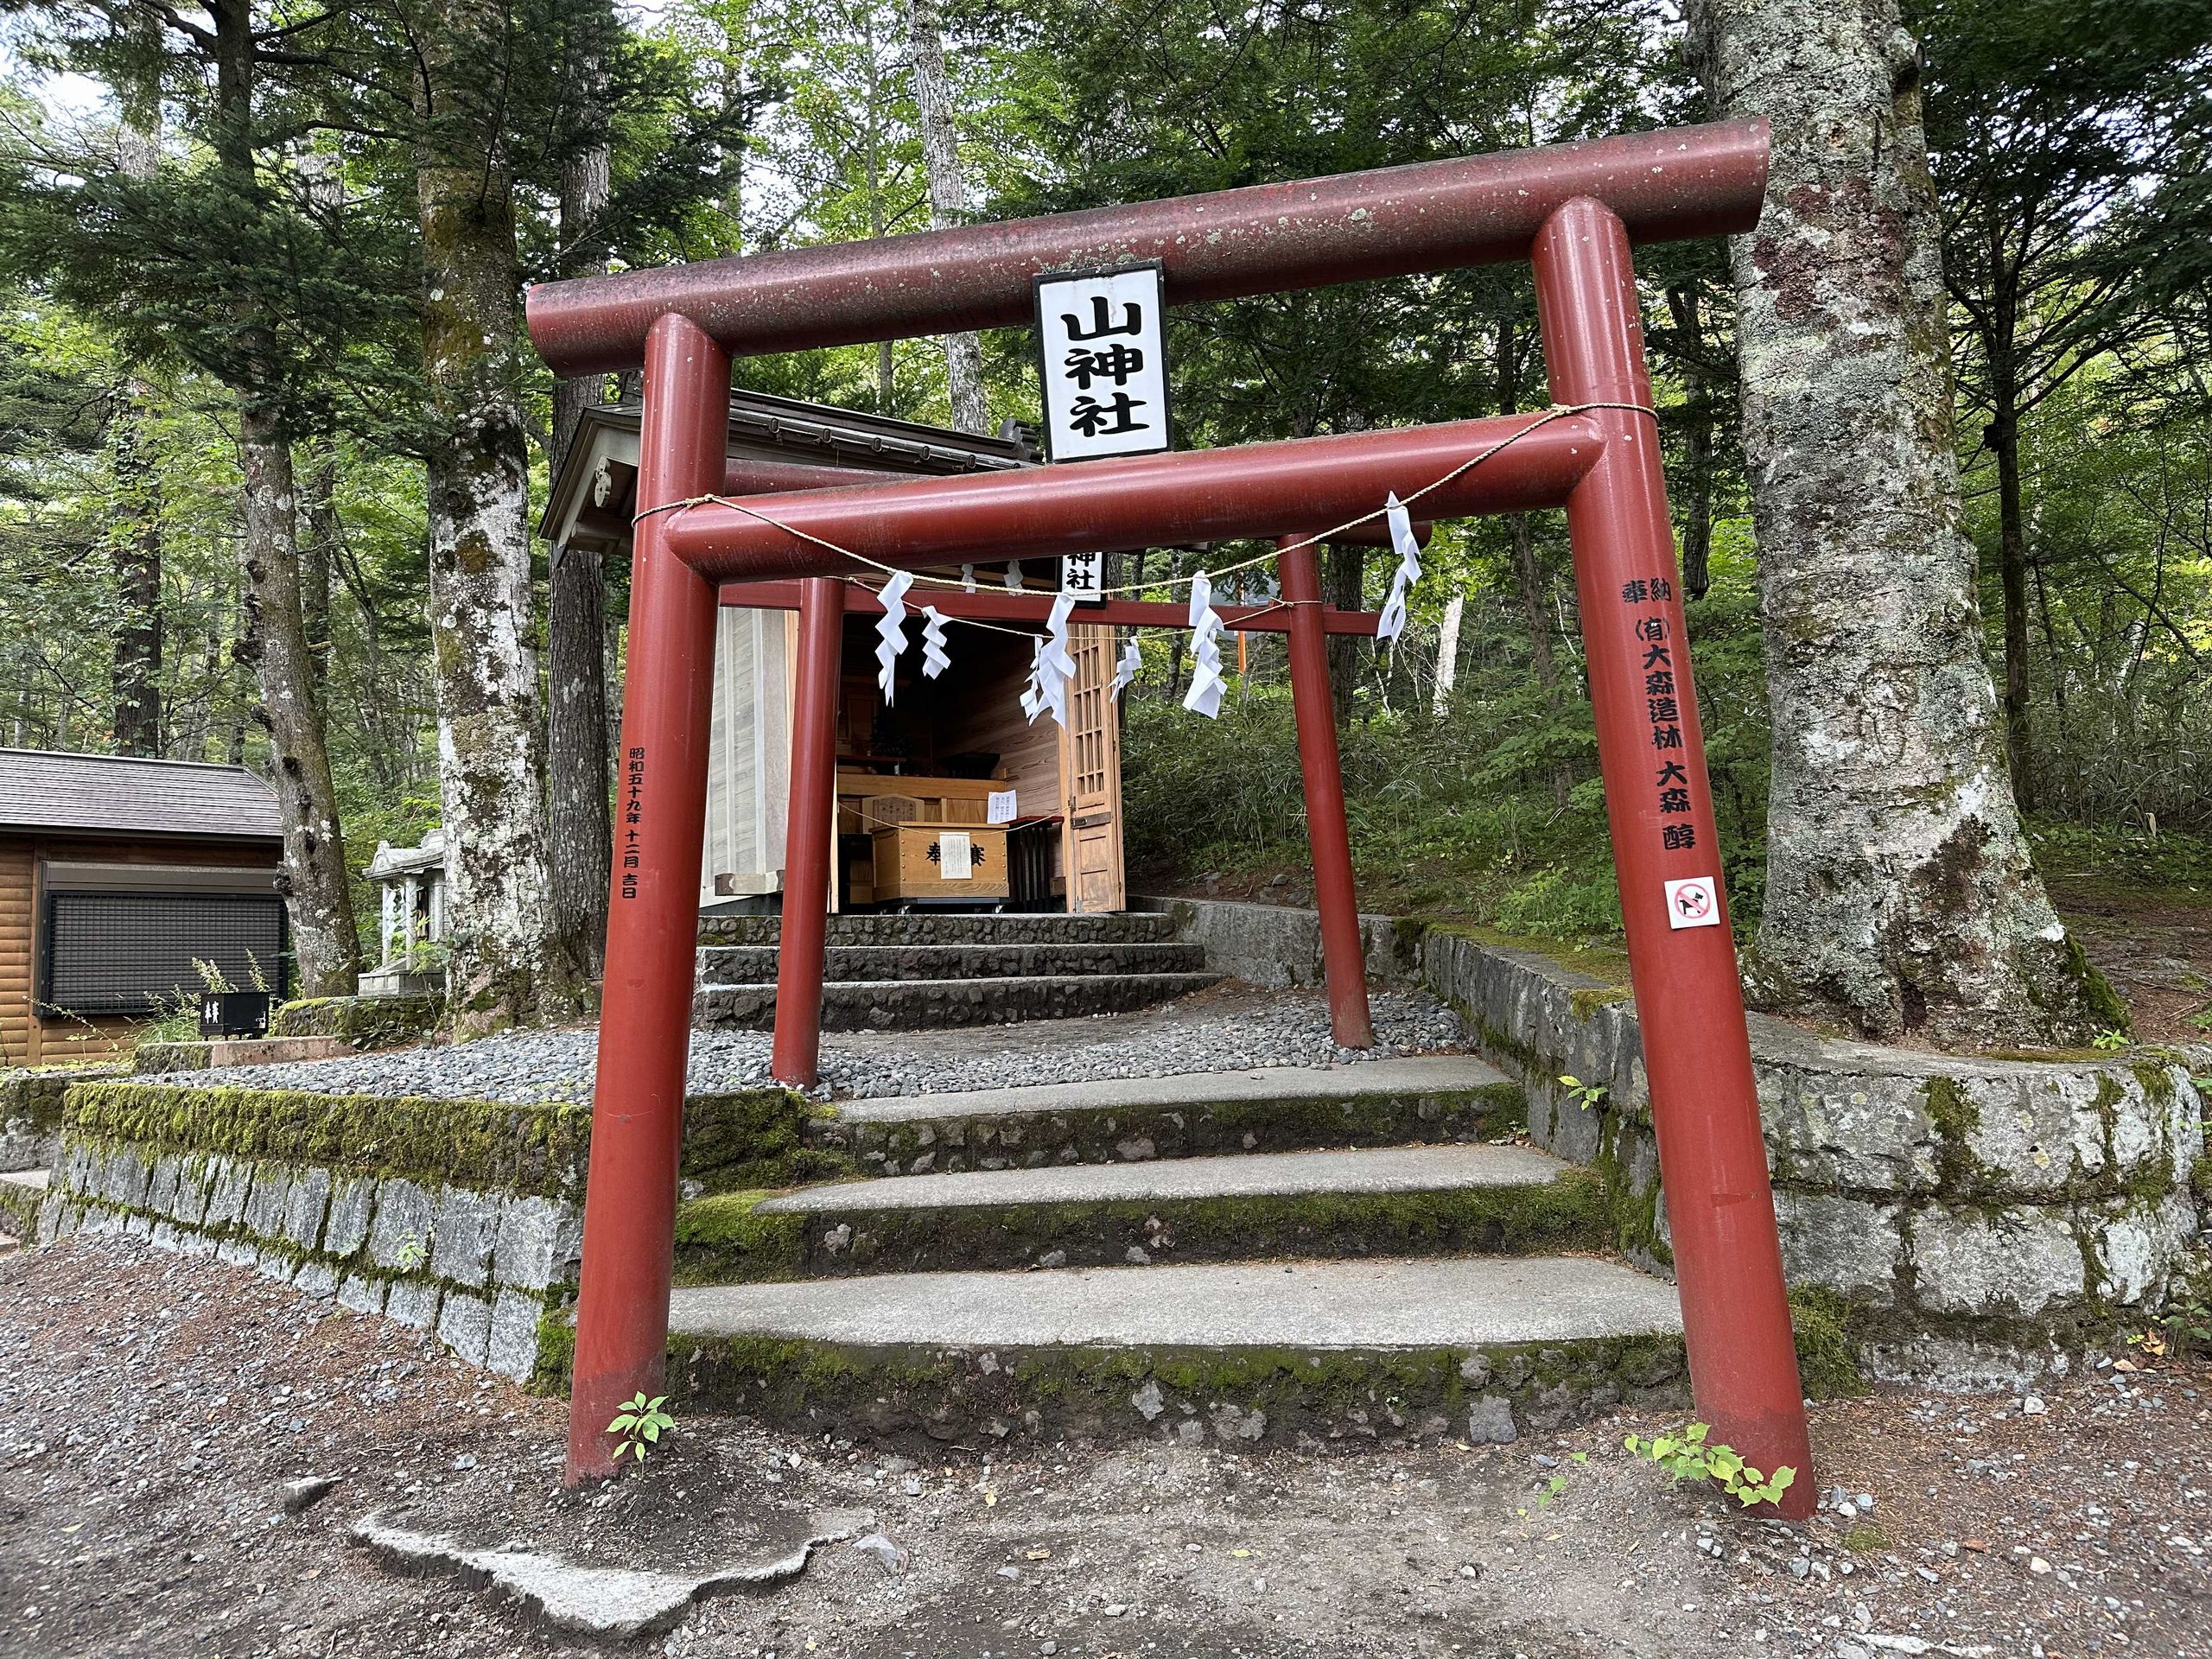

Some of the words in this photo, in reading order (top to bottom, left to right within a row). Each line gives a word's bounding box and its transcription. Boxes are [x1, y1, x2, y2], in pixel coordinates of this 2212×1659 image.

[1060, 296, 1150, 438] 山神社
[1622, 578, 1672, 604] 奉納
